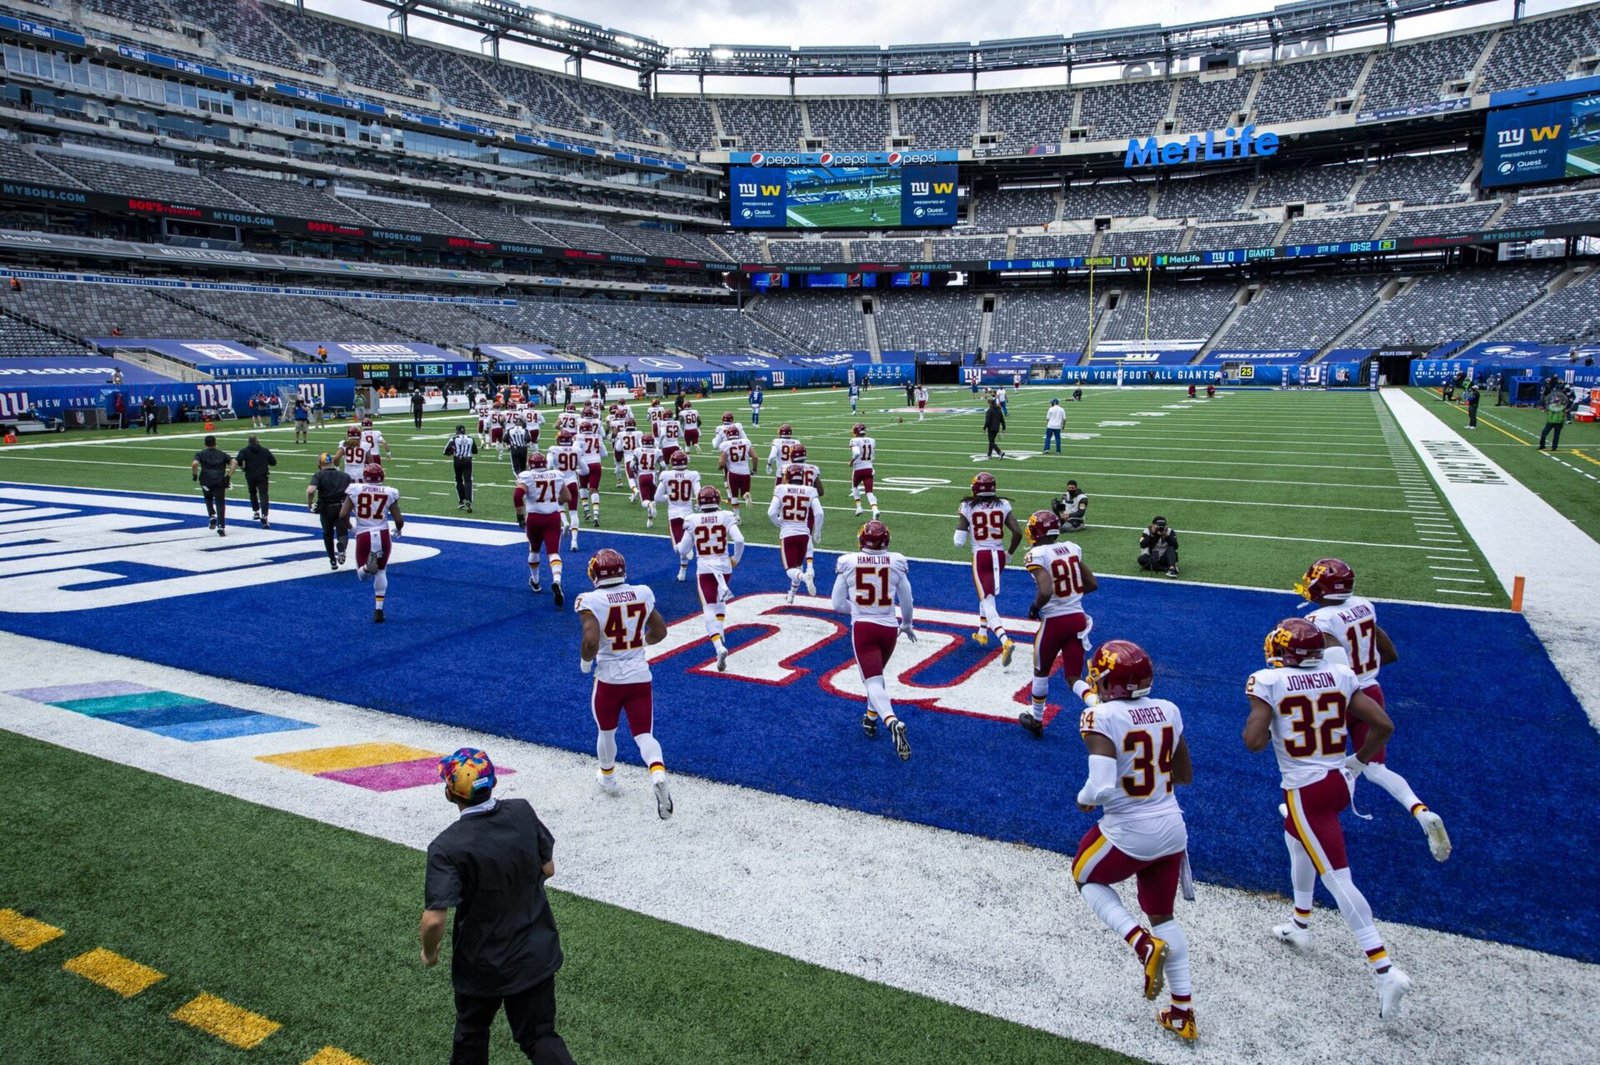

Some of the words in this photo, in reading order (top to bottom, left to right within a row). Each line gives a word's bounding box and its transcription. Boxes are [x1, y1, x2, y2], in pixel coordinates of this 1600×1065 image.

[1497, 128, 1524, 148] ny
[1124, 124, 1279, 168] MetLife
[766, 155, 800, 167] pepsi
[834, 154, 868, 167] pepsi
[903, 152, 937, 165] pepsi
[1517, 159, 1541, 167] Quest
[3, 184, 85, 203] MYBOBS.COM
[739, 183, 757, 197] ny
[910, 182, 929, 196] ny
[213, 211, 275, 226] MYBOBS.COM
[373, 230, 422, 243] MYBOBS.COM
[1483, 229, 1545, 241] MYBOBS.COM
[501, 244, 543, 255] MYBOBS.COM
[1248, 248, 1275, 258] GIANTS
[1350, 241, 1371, 251] 10:52
[1169, 255, 1200, 264] MetLife
[209, 368, 229, 376] NEW
[235, 367, 257, 375] YORK
[263, 366, 304, 375] FOOTBALL
[309, 366, 338, 374] GIANTS
[1067, 371, 1088, 380] NEW
[1094, 371, 1118, 380] YORK
[1123, 371, 1172, 380] FOOTALL
[1178, 370, 1214, 380] GIANTS
[1241, 367, 1252, 375] 25
[37, 399, 60, 408] NEW
[69, 397, 96, 407] YORK
[161, 393, 195, 402] GIANTS
[506, 413, 518, 423] 75
[526, 412, 538, 423] 94
[562, 417, 576, 429] 73
[685, 414, 696, 424] 60
[666, 425, 679, 438] 52
[584, 438, 600, 454] 74
[623, 435, 636, 450] 31
[345, 448, 364, 463] 99
[729, 445, 747, 462] 67
[861, 444, 872, 461] 11
[558, 453, 578, 471] 90
[639, 453, 655, 470] 41
[362, 485, 385, 493] SPRINKLE
[535, 480, 557, 503] 71
[667, 479, 692, 501] 30
[357, 493, 388, 519] 87
[782, 495, 808, 521] 25
[971, 510, 1005, 541] 89
[694, 524, 727, 556] 23
[857, 555, 891, 565] HAMILTON
[1051, 555, 1084, 598] 80
[855, 566, 892, 606] 51
[606, 590, 637, 604] HUDSON
[604, 602, 647, 650] 47
[1274, 626, 1293, 648] 32
[1346, 618, 1379, 676] 17
[1286, 672, 1337, 692] JOHNSON
[1128, 706, 1167, 725] BARBER
[1278, 691, 1348, 758] 32
[1120, 726, 1174, 798] 34
